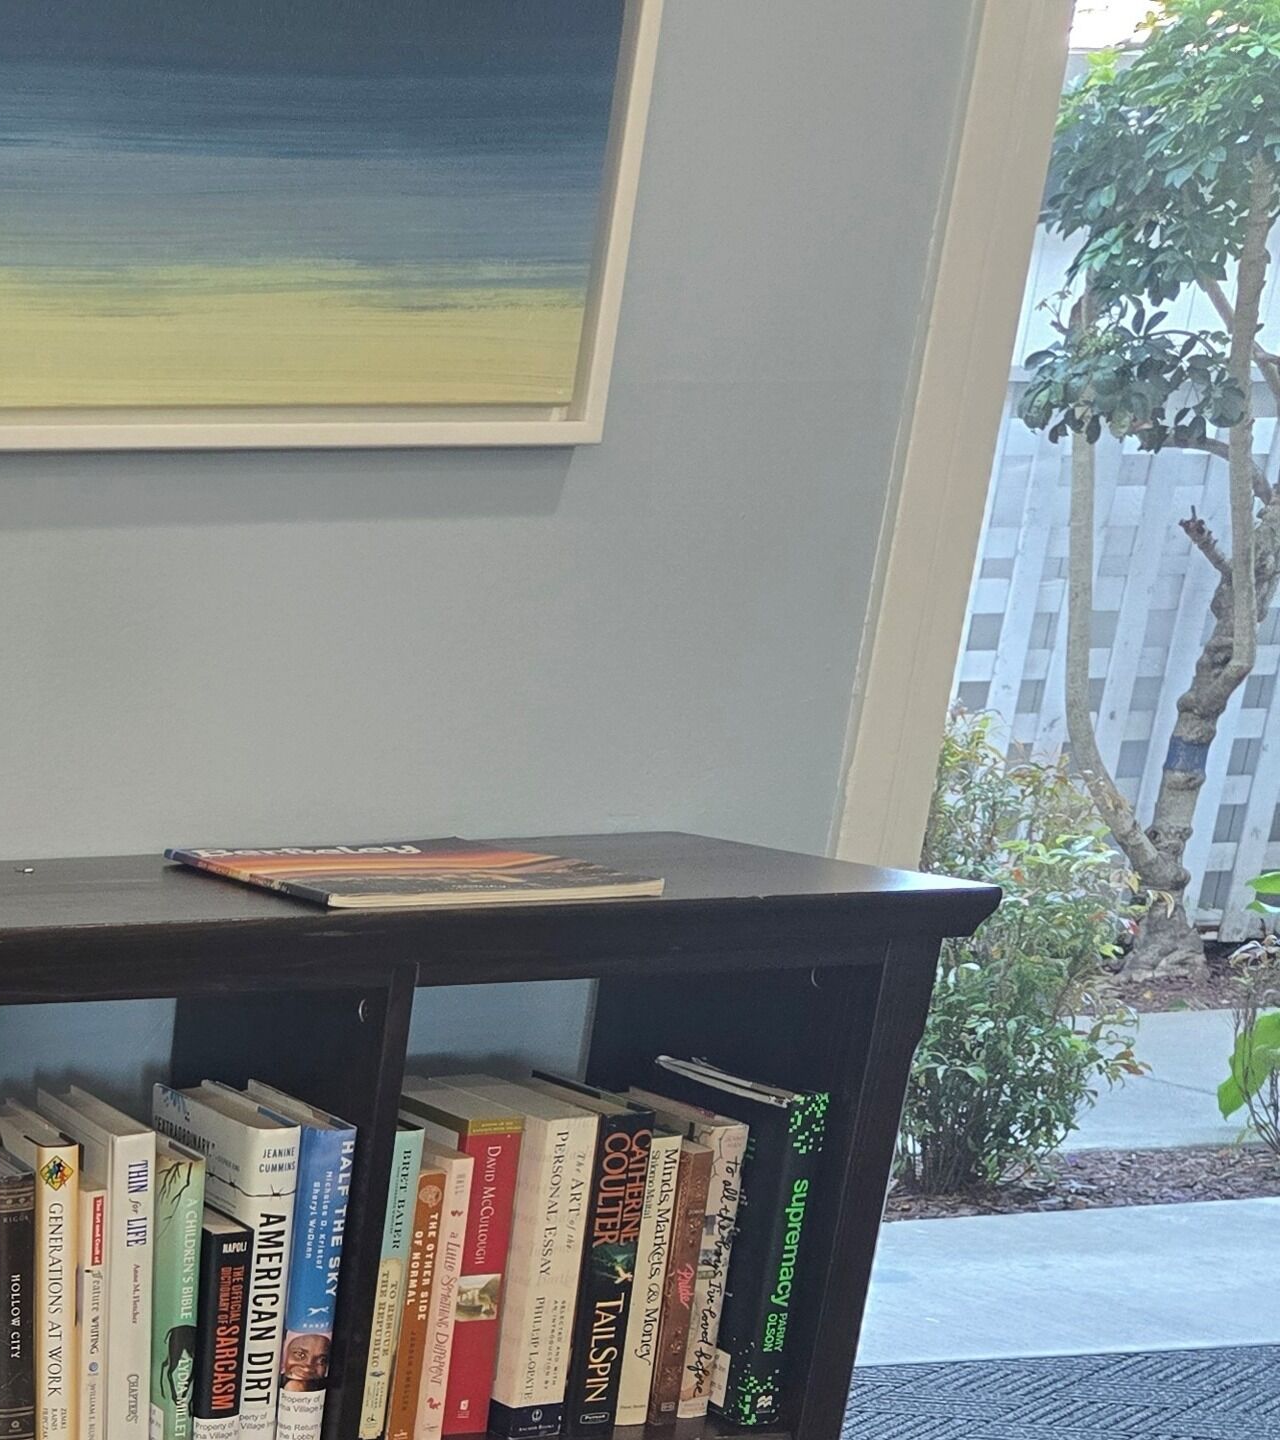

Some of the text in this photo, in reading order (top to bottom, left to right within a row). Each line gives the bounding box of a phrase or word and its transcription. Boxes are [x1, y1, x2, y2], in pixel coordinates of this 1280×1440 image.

[259, 1161, 296, 1173] CUMMINS
[262, 1147, 295, 1159] JEANINE
[399, 1150, 412, 1193] BRET
[592, 1132, 631, 1248] COULTER
[620, 1129, 654, 1246] CATHERINE
[126, 1160, 148, 1247] THIN for LIFE
[305, 1181, 321, 1259] Sheryl WuDunn
[325, 1140, 355, 1296] HALF THE SKY
[392, 1199, 406, 1249] BAIER
[540, 1131, 569, 1276] PERSONAL ESSAY
[222, 1242, 247, 1254] NAPOLI
[407, 1231, 424, 1306] OF NORMAL
[417, 1212, 439, 1321] THE OTHER SIDE
[635, 1148, 679, 1366] Minds, Markets, & Money
[770, 1178, 809, 1307] supremacy
[10, 1275, 21, 1359] HOLLOW CITY
[47, 1203, 64, 1397] GENERATIONS AT WORK
[229, 1266, 245, 1324] THE OFFICIAL
[243, 1213, 287, 1404] AMERICAN DIRT
[383, 1281, 398, 1356] TO RESCUE
[763, 1313, 778, 1352] OLSON
[774, 1313, 788, 1352] PARMY
[211, 1267, 240, 1410] DICTIONARY OF SARCASM
[584, 1292, 625, 1403] TAILSPIN
[174, 1358, 193, 1437] LYDIA MILLET
[196, 1422, 226, 1431] Property
[209, 1431, 233, 1439] Village
[241, 1422, 266, 1430] Village
[281, 1396, 312, 1404] Property
[294, 1404, 318, 1413] Village
[294, 1423, 318, 1431] Return
